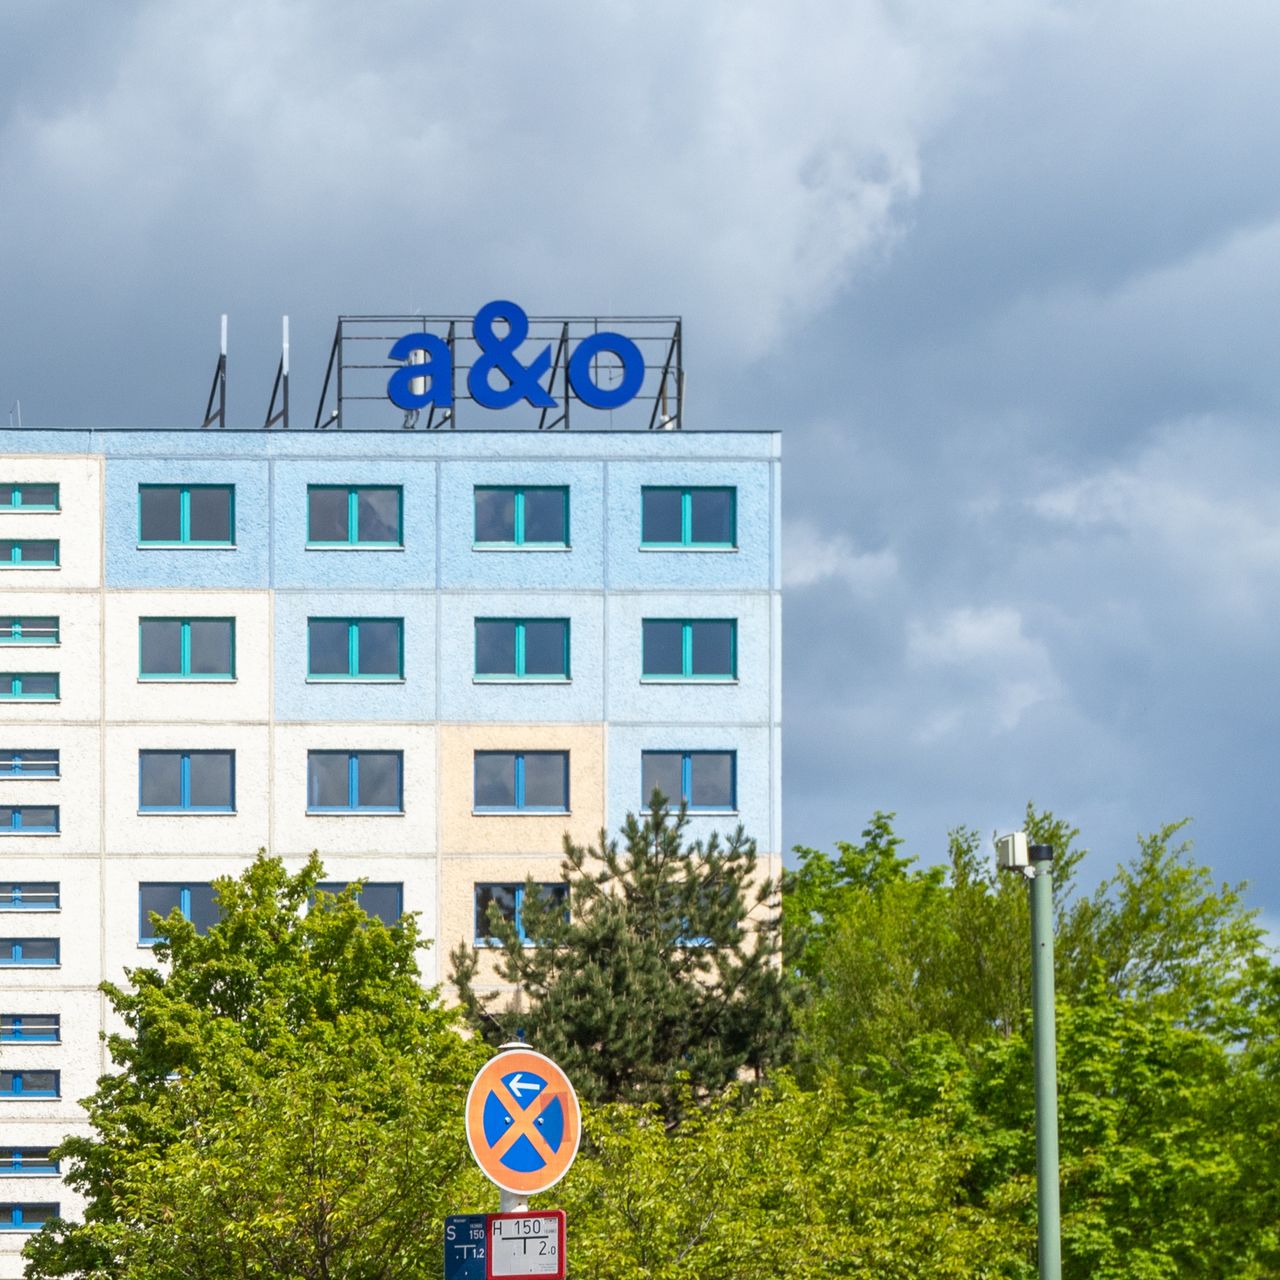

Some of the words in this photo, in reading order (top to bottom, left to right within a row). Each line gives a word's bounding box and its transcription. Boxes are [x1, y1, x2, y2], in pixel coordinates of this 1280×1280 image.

[387, 299, 645, 410] a&o
[447, 1226, 456, 1240] S
[469, 1230, 485, 1239] 150
[493, 1221, 502, 1236] H
[514, 1219, 541, 1234] 150
